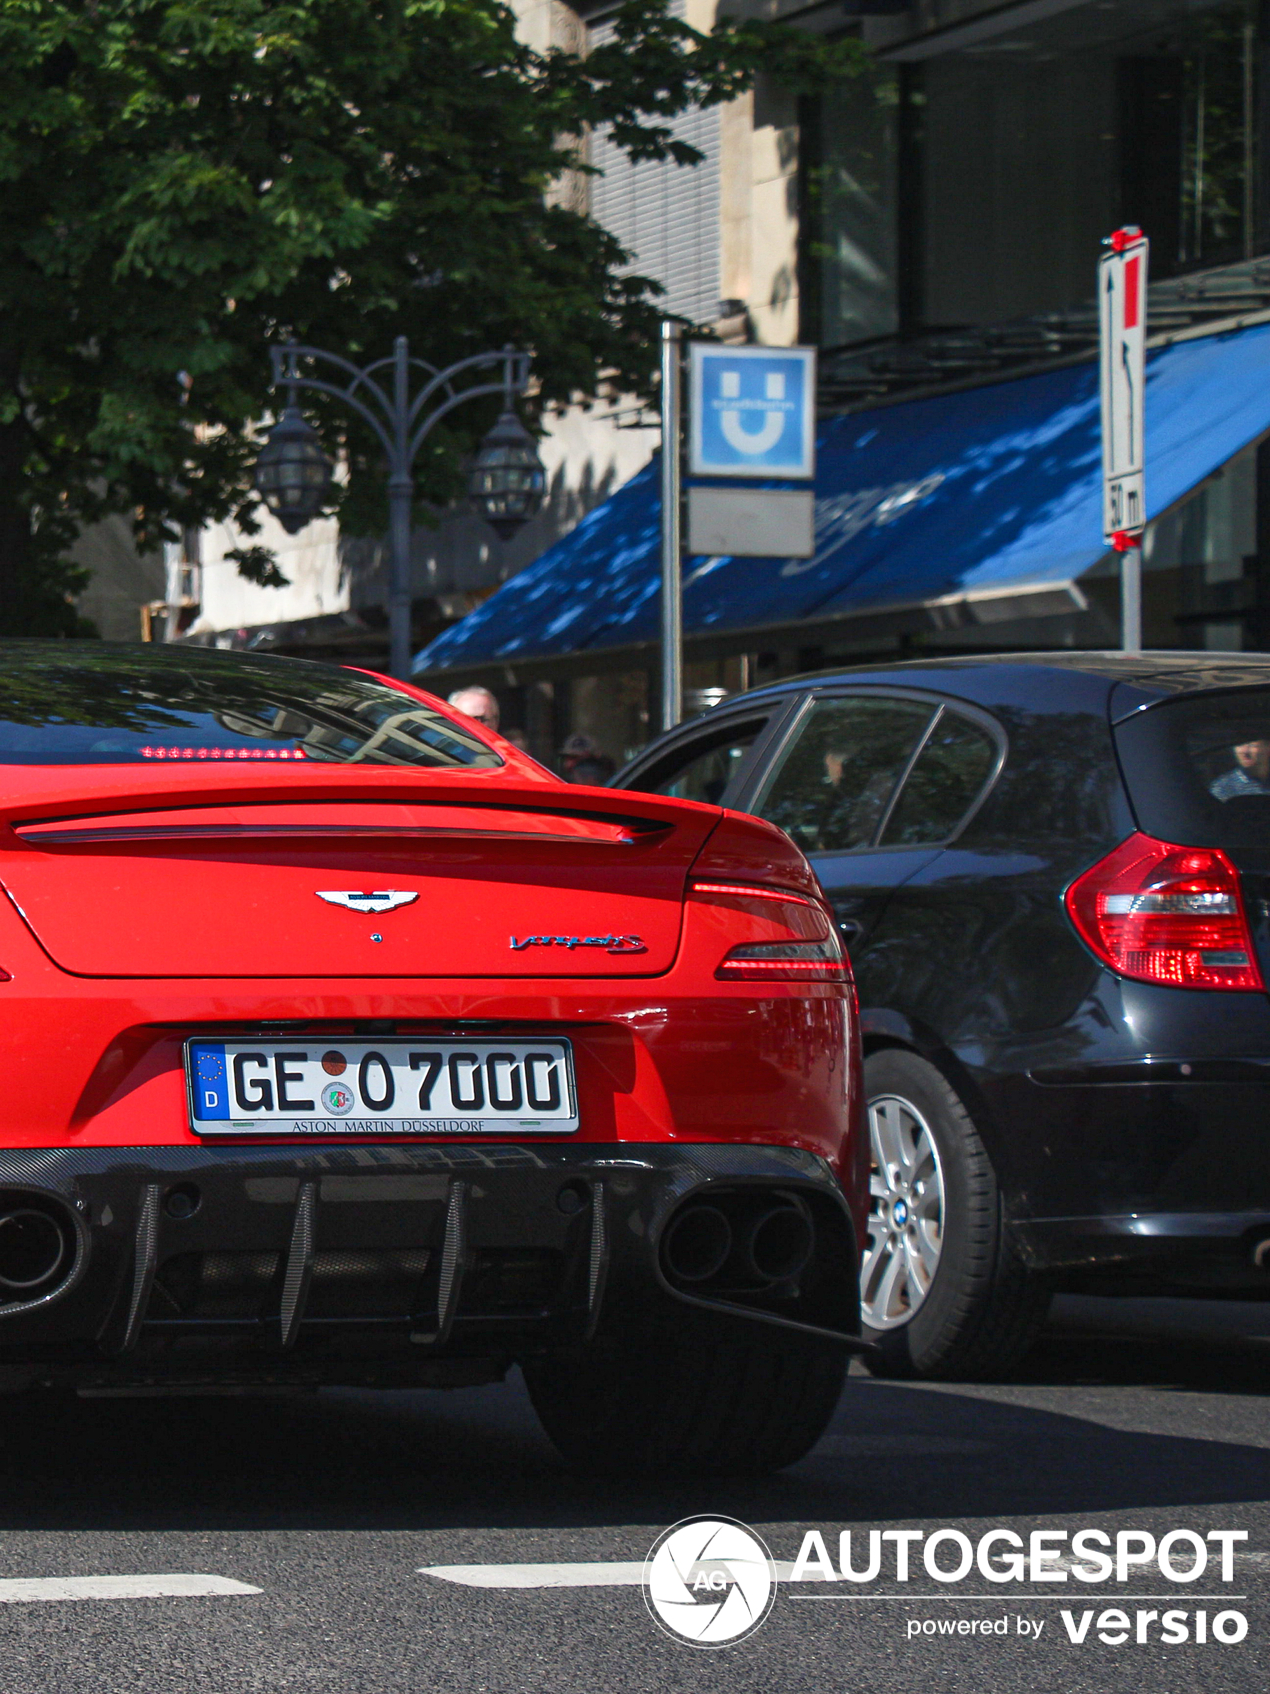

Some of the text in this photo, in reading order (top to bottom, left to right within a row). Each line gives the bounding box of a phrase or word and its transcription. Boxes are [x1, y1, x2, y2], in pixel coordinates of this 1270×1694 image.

[232, 1052, 315, 1112] GE
[408, 1052, 561, 1112] 7000
[205, 1091, 218, 1107] D
[292, 1118, 485, 1133] ASTON MARTIN DÜSSELDORF
